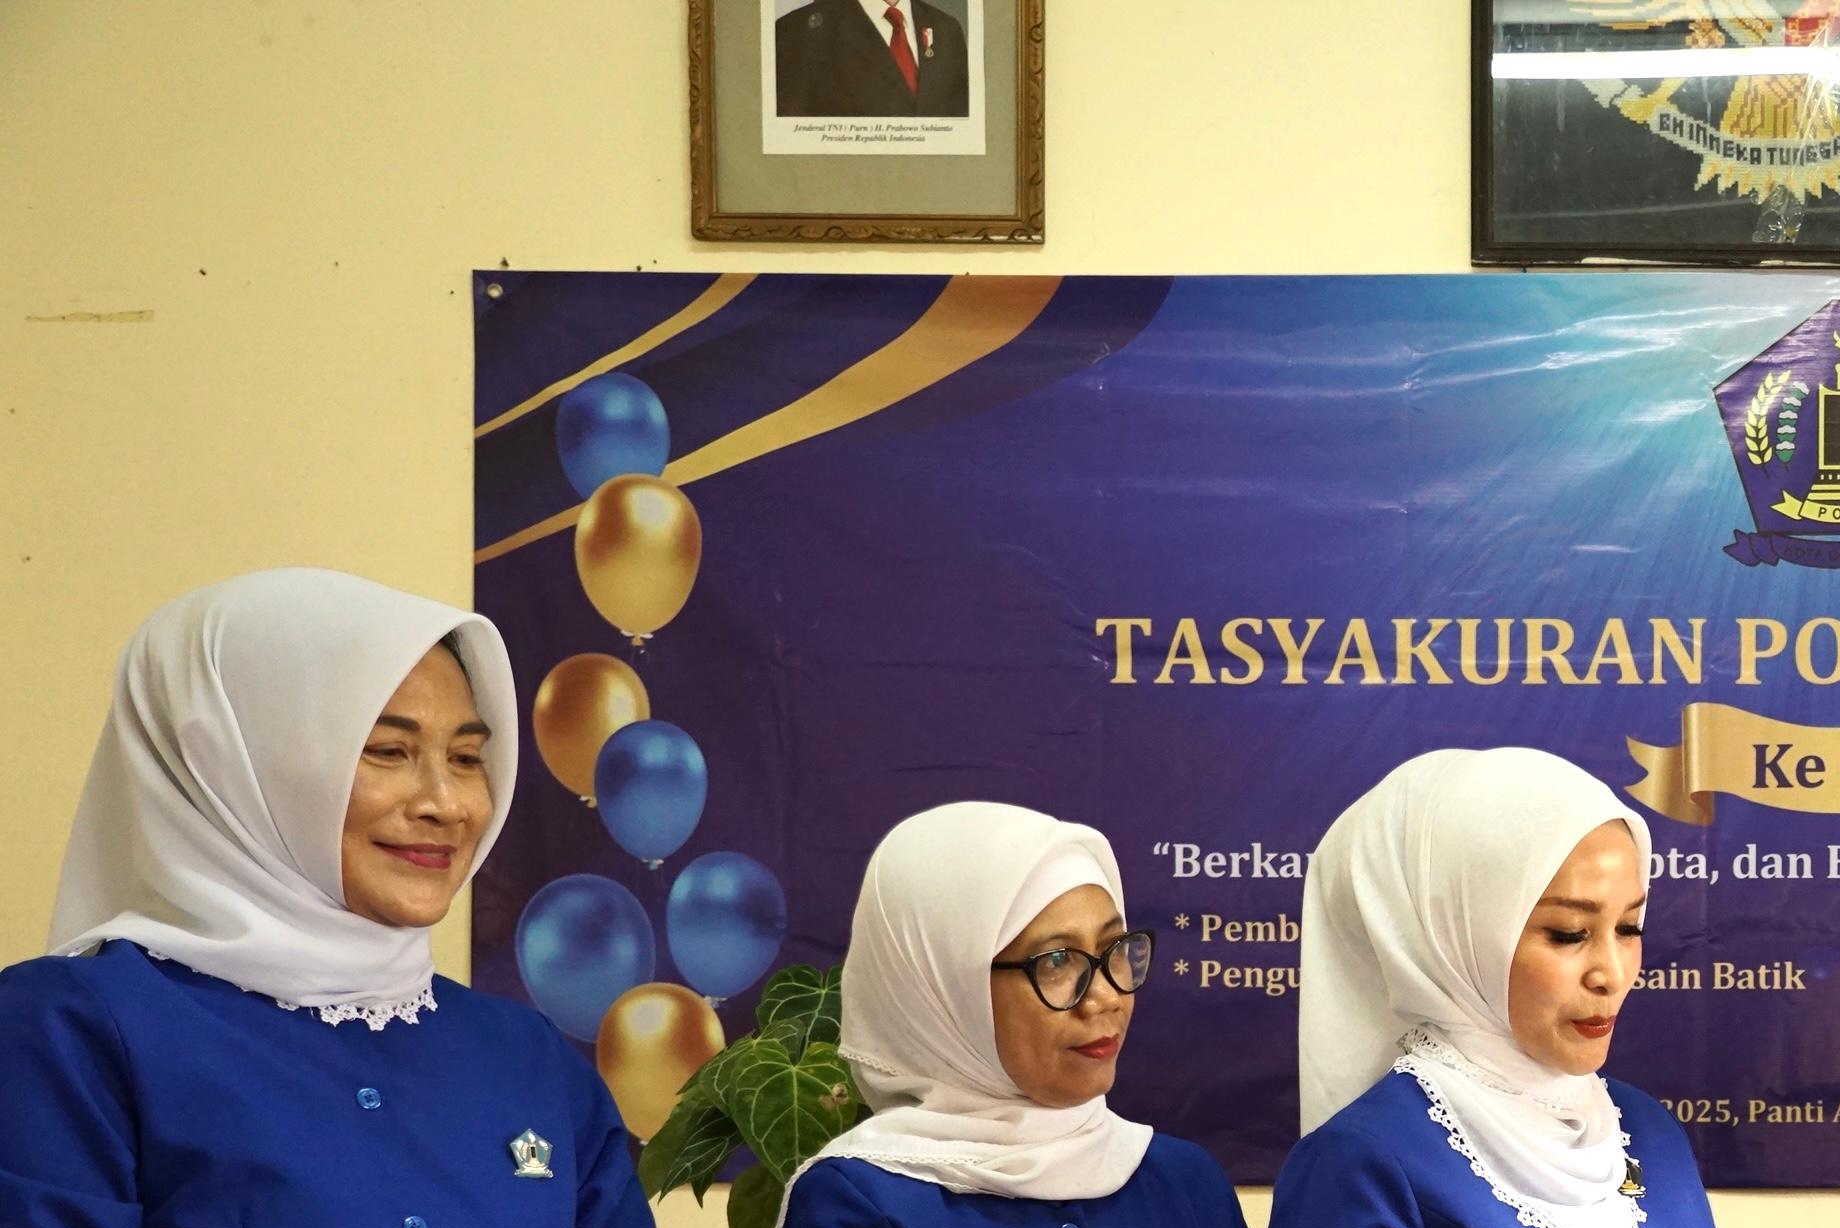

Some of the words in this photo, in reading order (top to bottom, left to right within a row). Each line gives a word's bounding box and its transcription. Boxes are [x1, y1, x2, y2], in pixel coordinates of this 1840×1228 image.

[1095, 617, 1708, 685] TASYAKURAN
[1752, 744, 1826, 788] Ke
[1649, 847, 1719, 889] pta,
[1732, 844, 1814, 880] dan
[1201, 913, 1300, 942] Pemb
[1200, 960, 1301, 996] Pengu
[1631, 962, 1702, 990] sain
[1713, 961, 1806, 990] Batik
[1748, 1099, 1824, 1123] Panti
